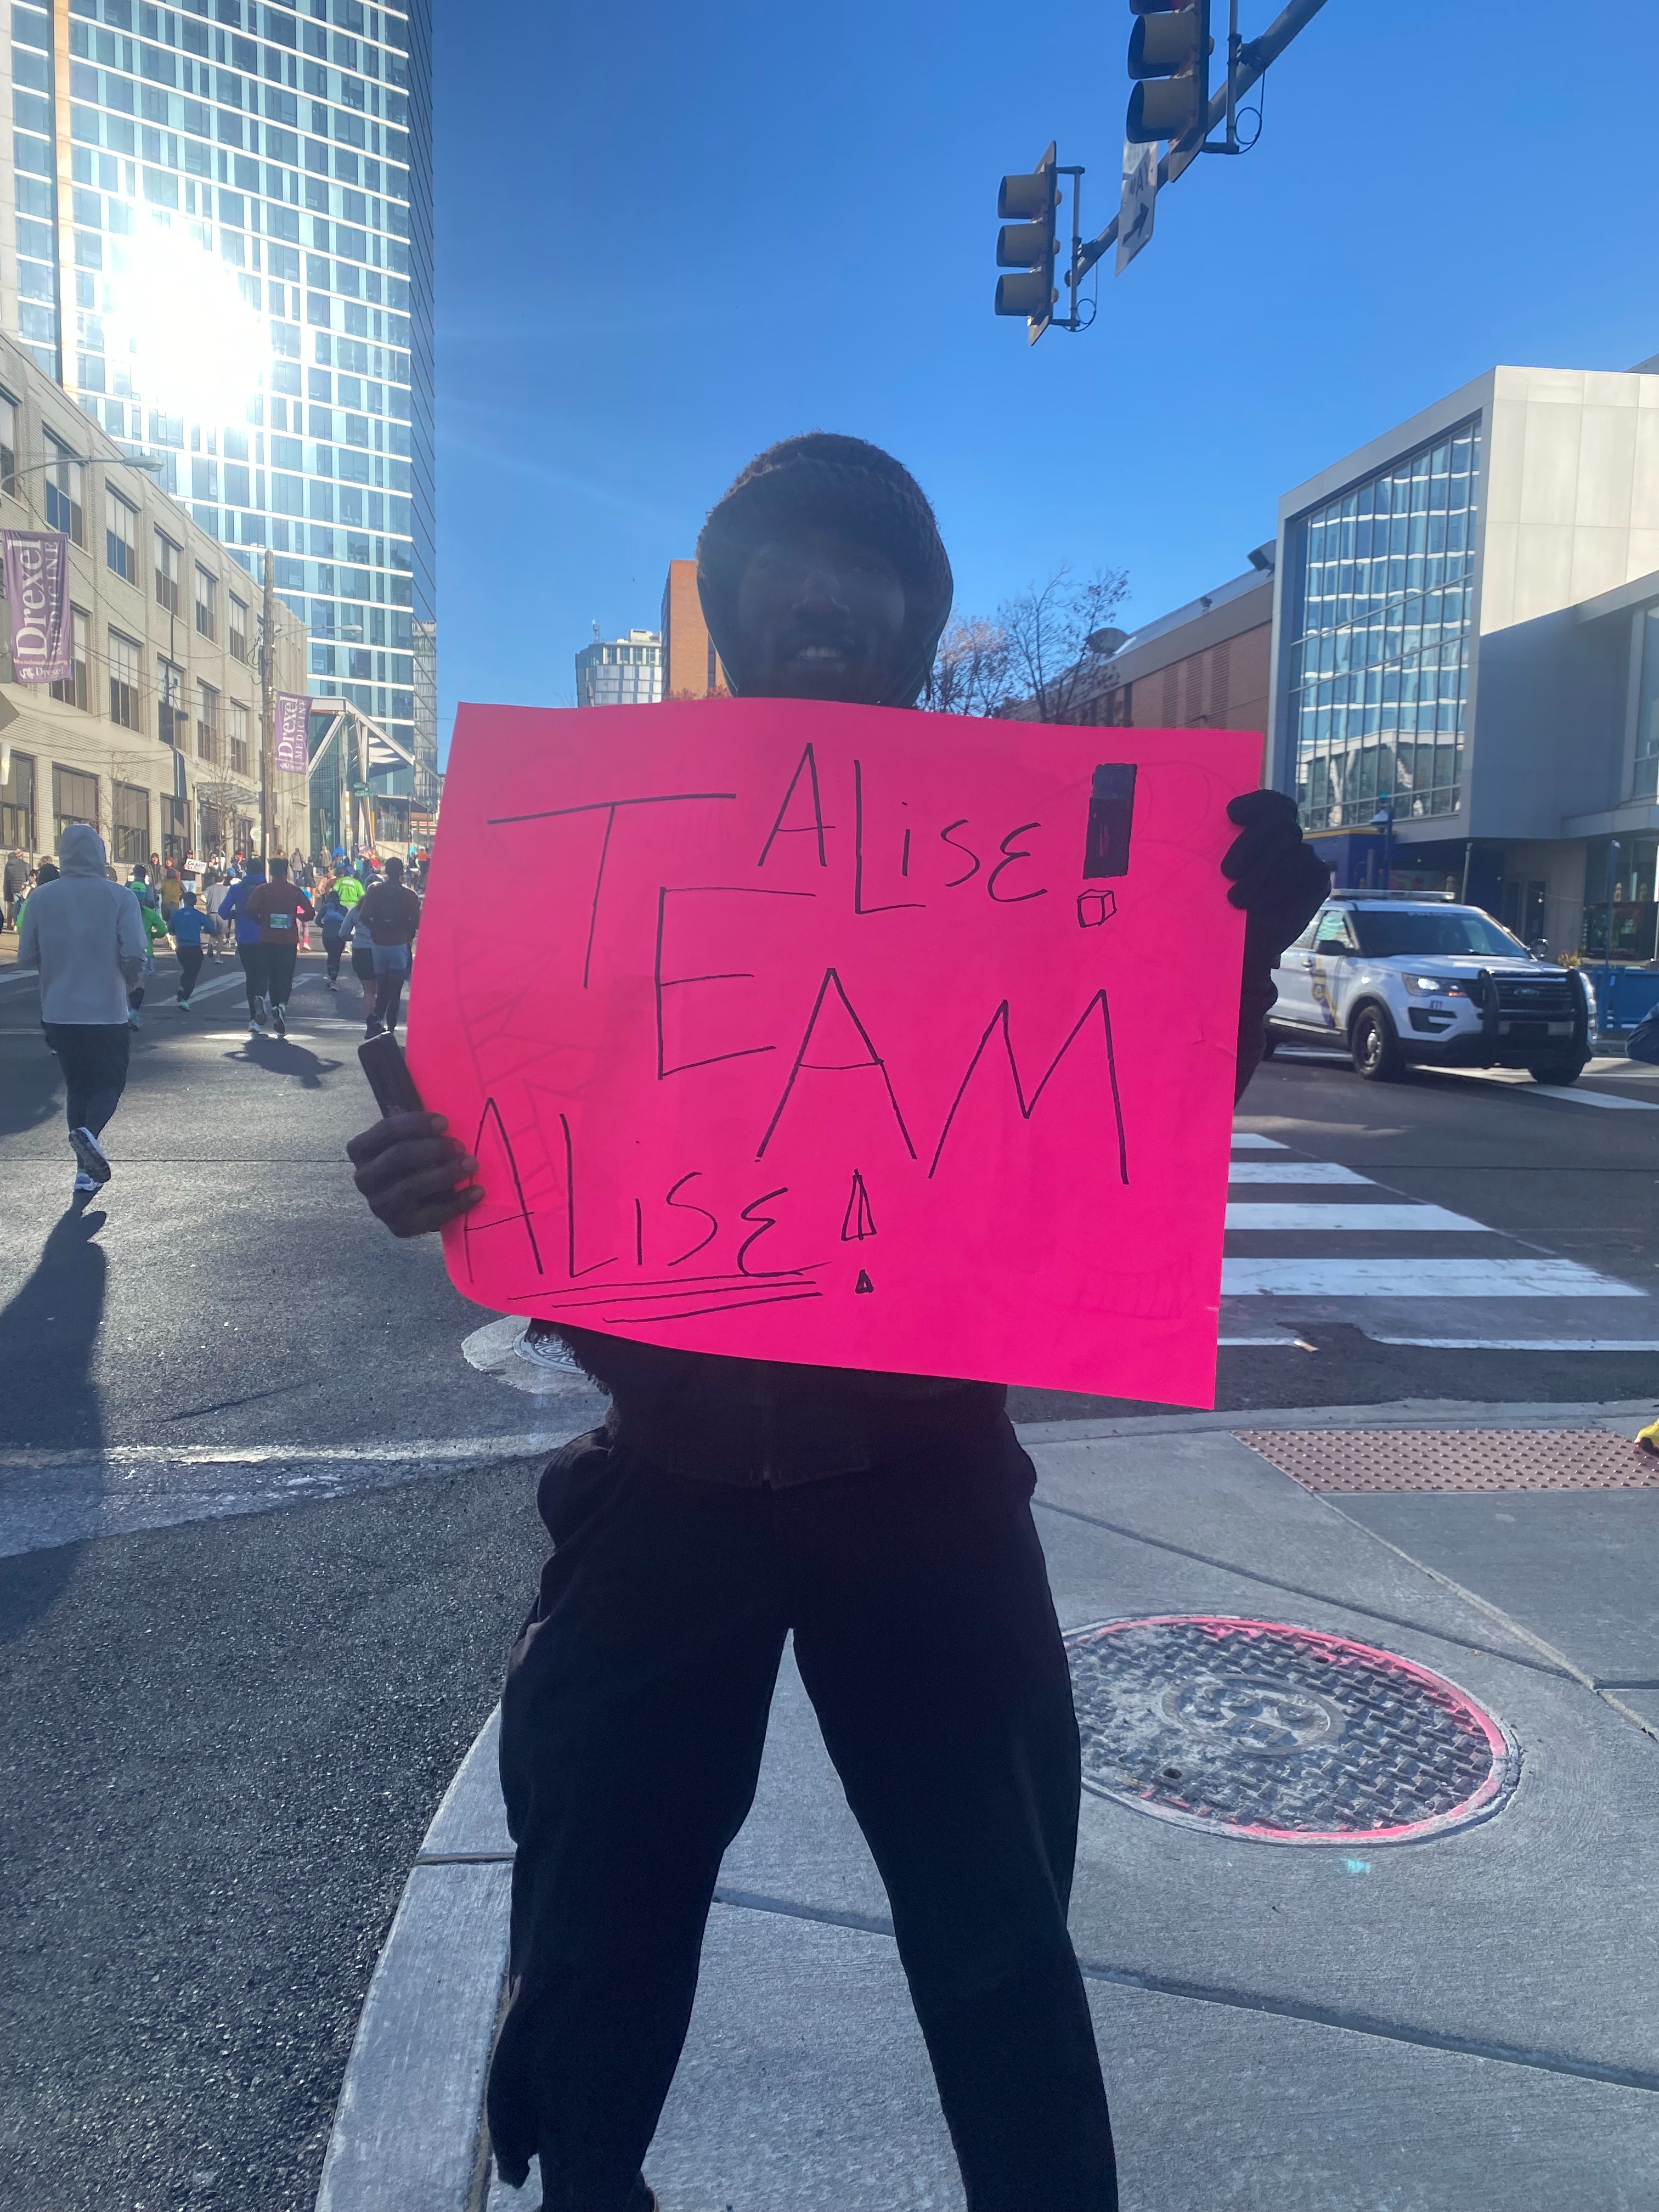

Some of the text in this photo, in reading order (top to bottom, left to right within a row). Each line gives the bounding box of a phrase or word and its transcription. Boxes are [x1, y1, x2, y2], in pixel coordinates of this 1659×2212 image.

[7, 539, 48, 659] Drexel
[45, 541, 63, 656] MEDICINE
[35, 665, 64, 676] Drexel
[278, 696, 298, 761] Drexel
[295, 698, 308, 759] MEDICINE
[488, 793, 1129, 1185] TEAM
